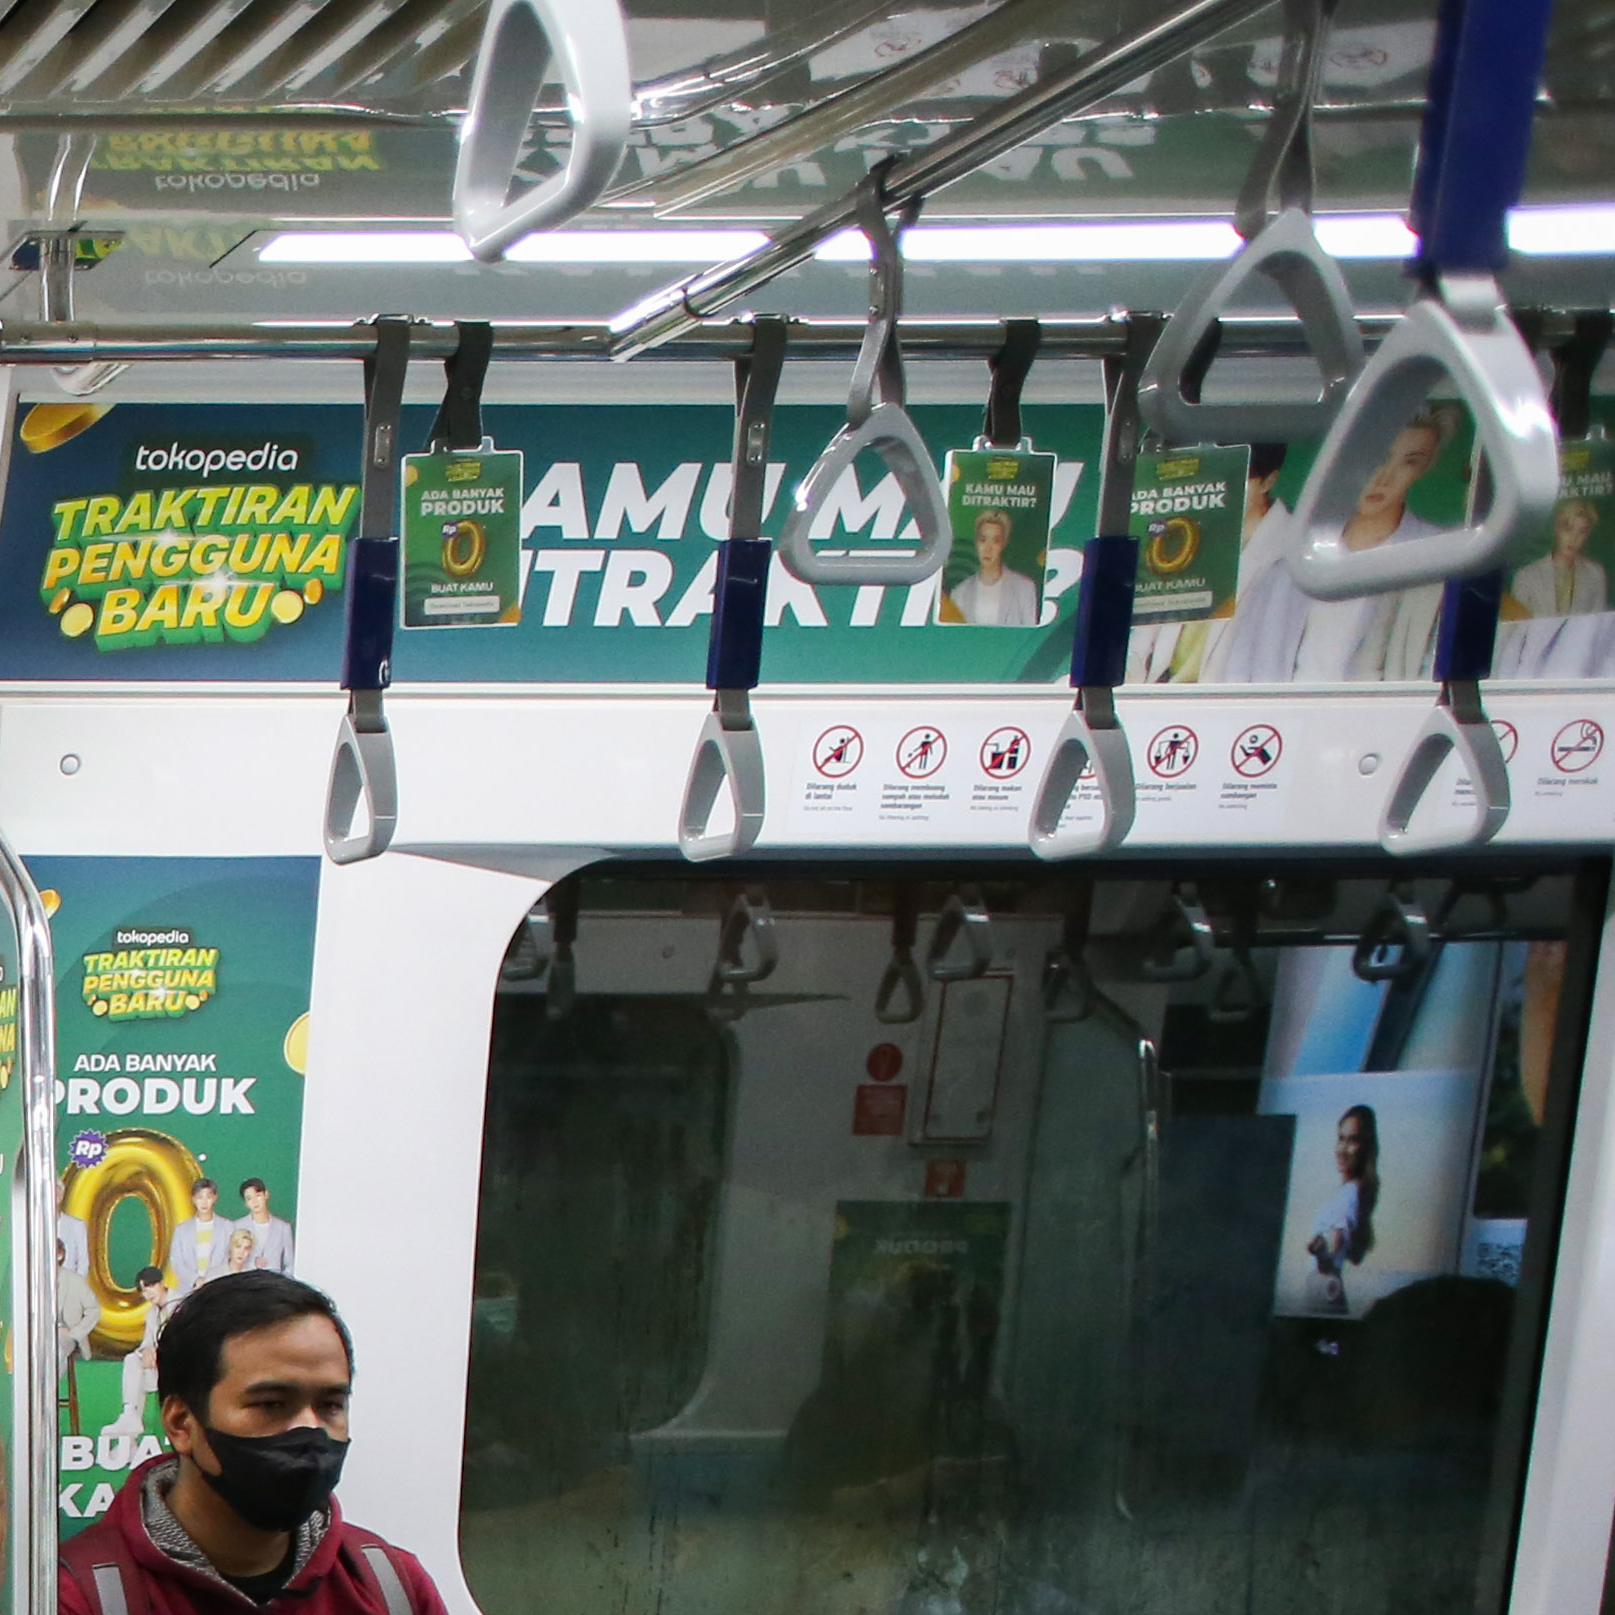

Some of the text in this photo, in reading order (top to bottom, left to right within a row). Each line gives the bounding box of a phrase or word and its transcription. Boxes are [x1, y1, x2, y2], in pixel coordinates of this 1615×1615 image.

[135, 442, 299, 477] tokopedia
[421, 487, 505, 500] ADA BANYAK
[961, 494, 1037, 508] DITRAKTIR?
[965, 484, 1036, 496] KAMU MAU
[1162, 482, 1227, 498] BANYAK
[420, 499, 505, 516] PRODUK
[520, 462, 785, 541] AMU
[53, 485, 359, 541] TRAKTIRAN
[42, 533, 342, 590] PENGGUNA
[431, 582, 493, 593] BUAT KAMU
[97, 582, 275, 636] BARU
[117, 930, 189, 946] tokopedia
[83, 948, 218, 973] TRAKTIRAN
[83, 969, 215, 994] PENGGUNA
[110, 990, 188, 1016] BARU
[73, 1053, 217, 1072] ADA BANYAK
[75, 1139, 103, 1159] Rp
[60, 1434, 171, 1472] BUA
